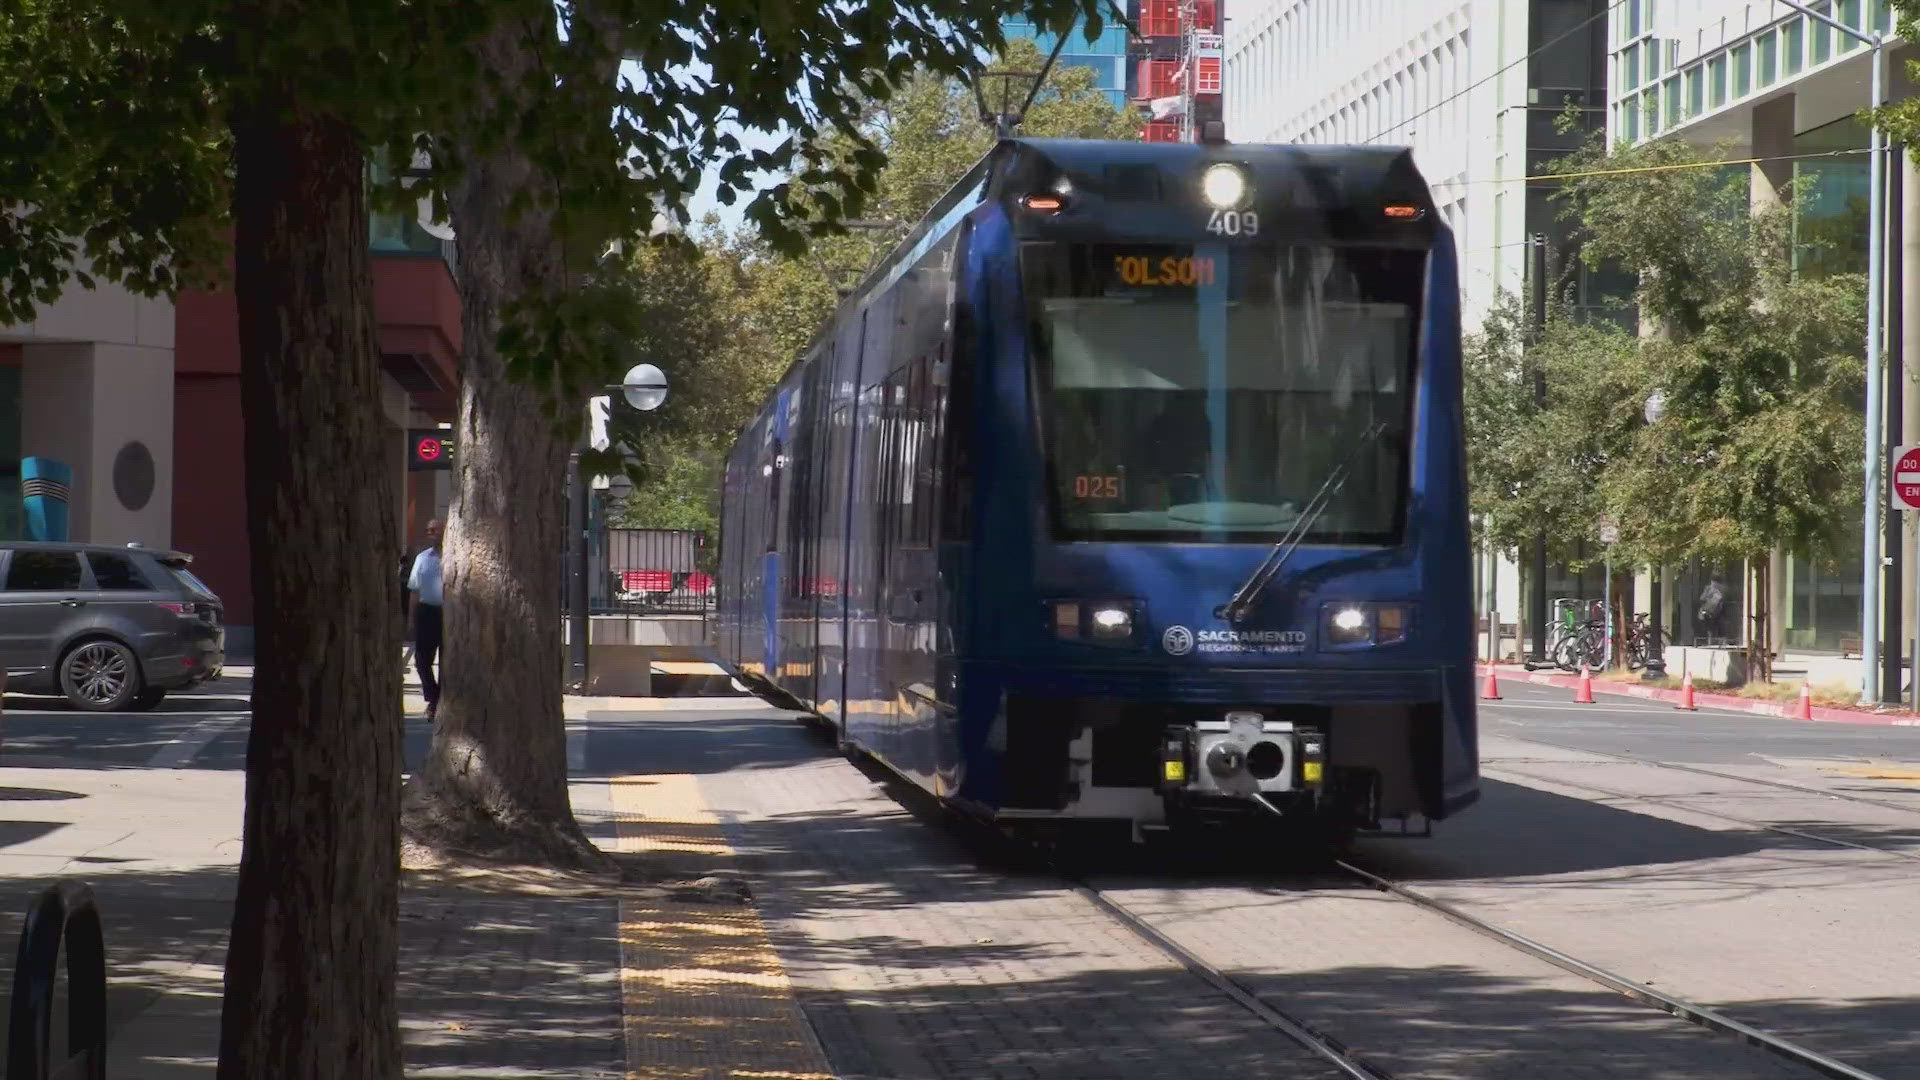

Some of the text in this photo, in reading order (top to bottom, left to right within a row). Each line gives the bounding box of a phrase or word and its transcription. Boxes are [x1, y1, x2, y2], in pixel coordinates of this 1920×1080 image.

[1206, 208, 1258, 236] 409
[1902, 459, 1917, 470] DO
[1075, 476, 1119, 498] 025
[1197, 630, 1307, 643] SACRAMENTO
